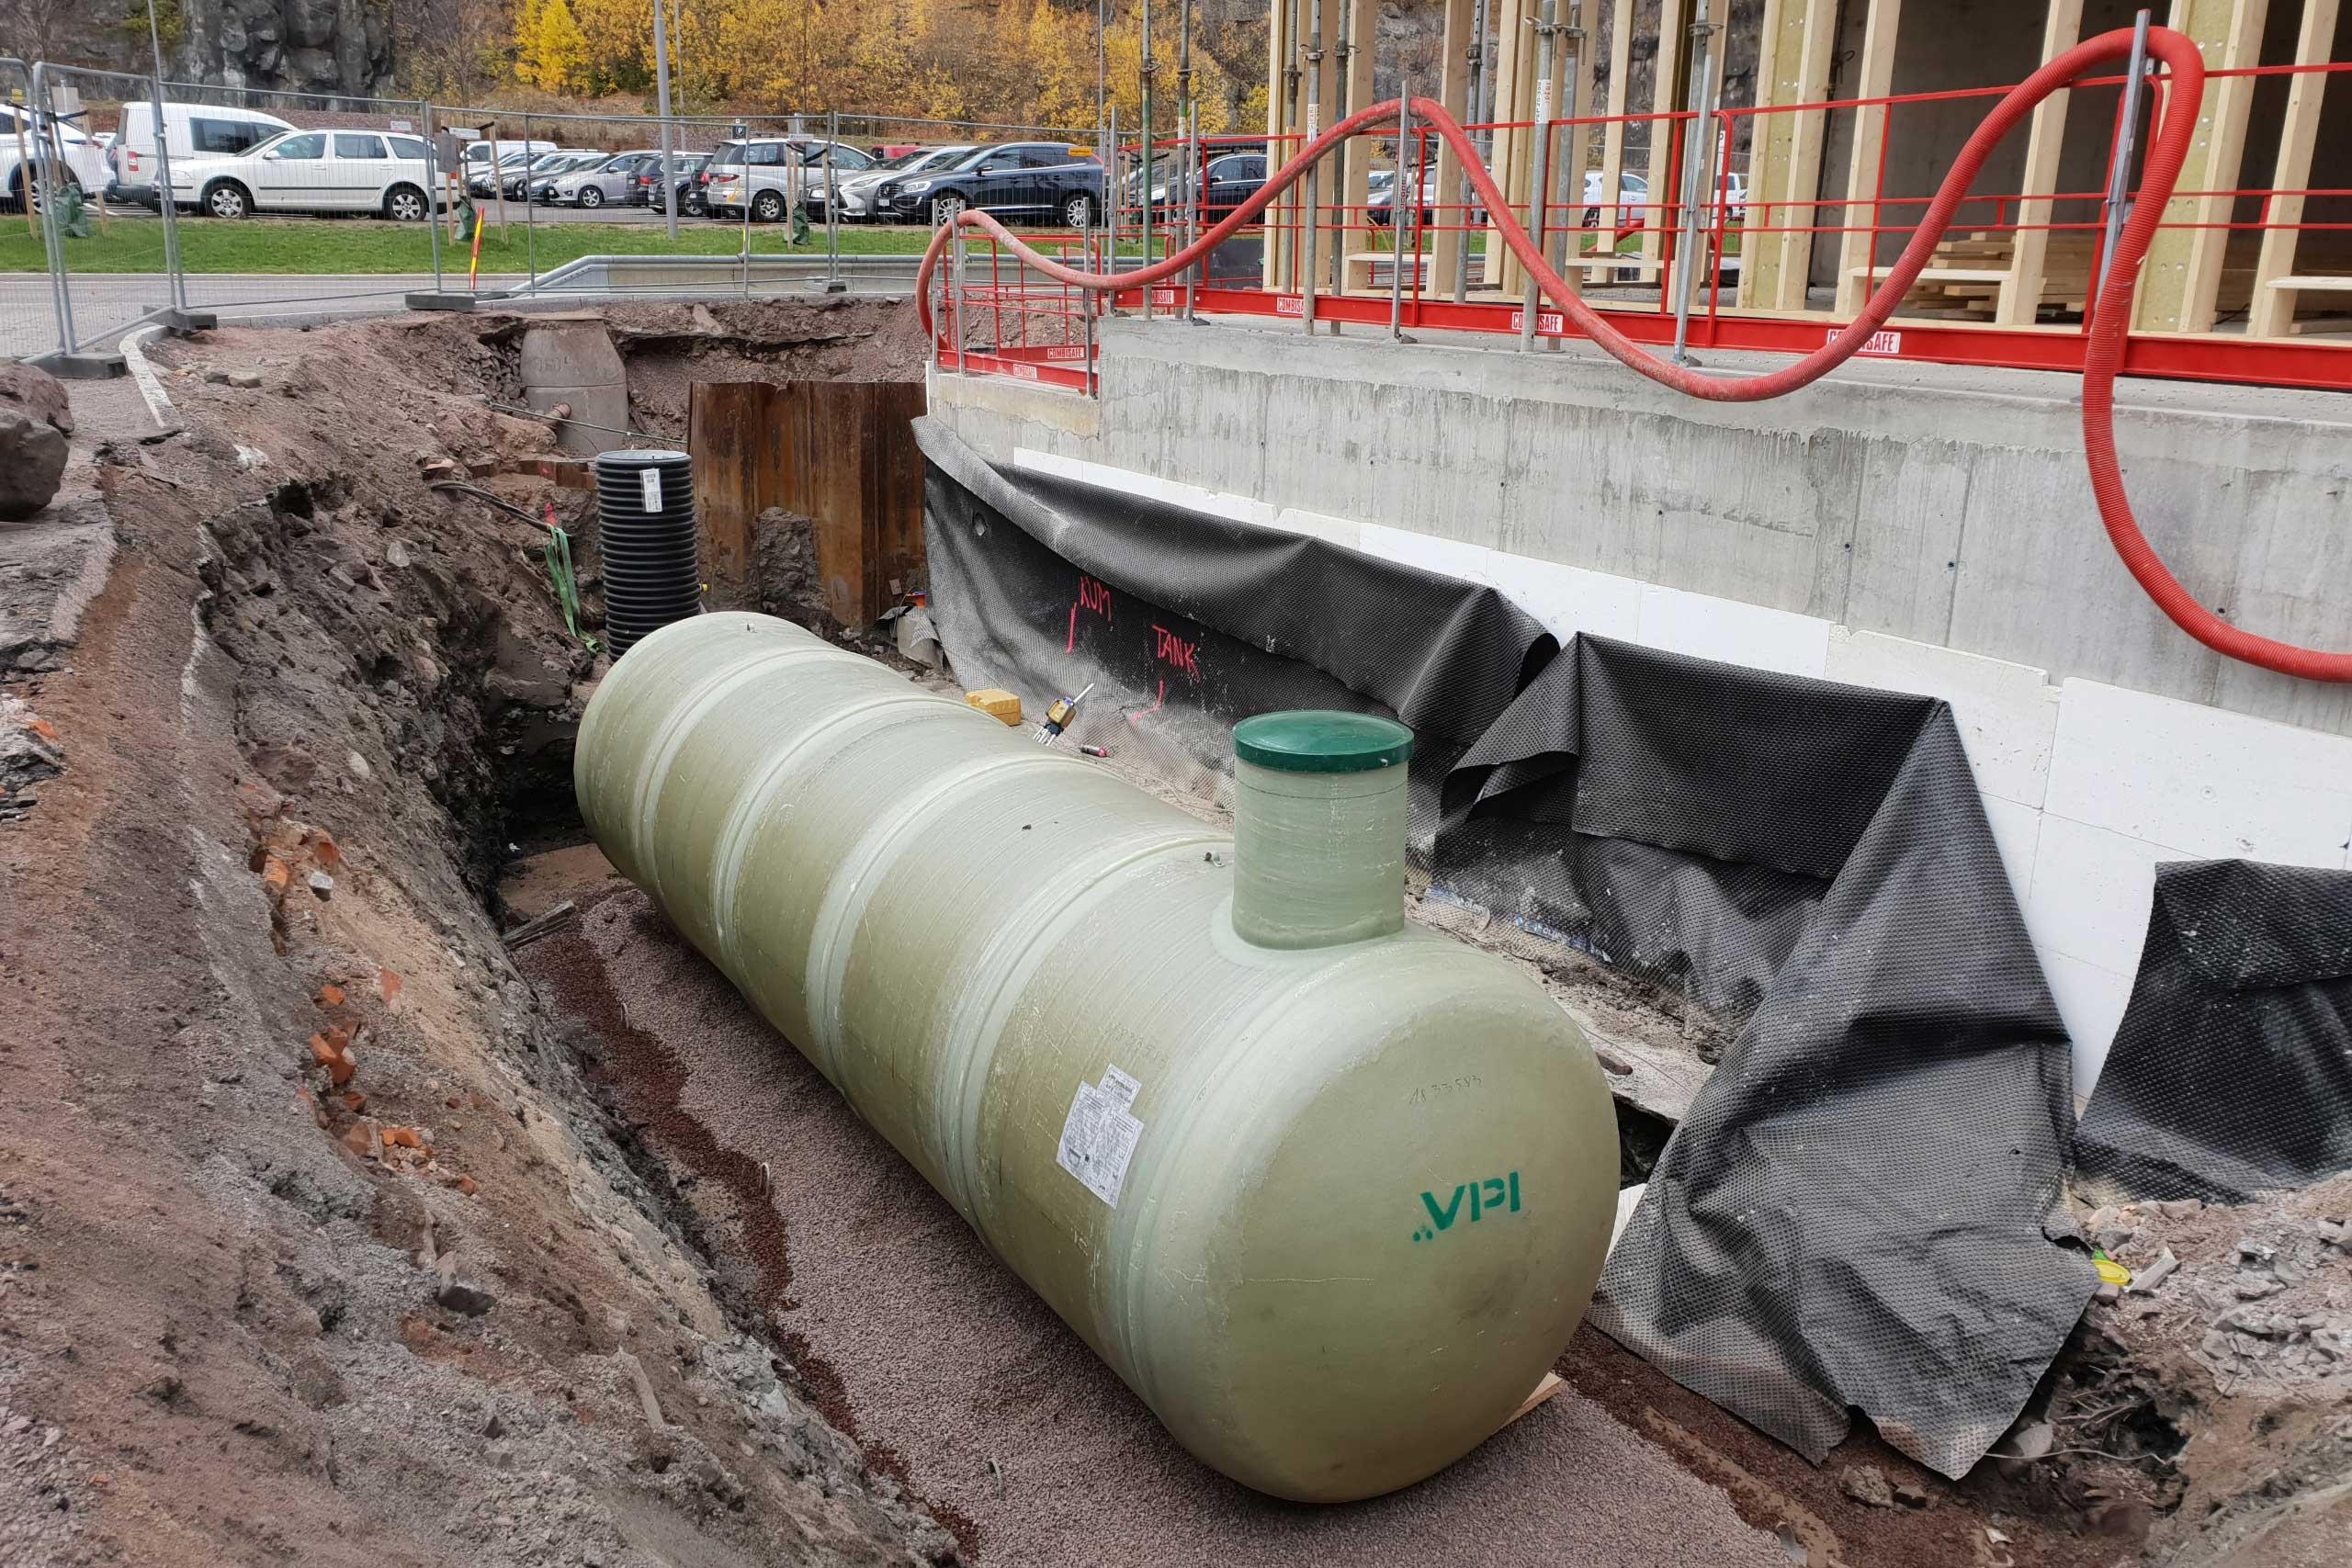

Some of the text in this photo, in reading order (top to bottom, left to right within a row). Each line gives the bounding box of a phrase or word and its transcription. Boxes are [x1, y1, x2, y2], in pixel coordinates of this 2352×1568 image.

[1513, 313, 1559, 332] COISAFE
[1828, 331, 1894, 351] CSAFE
[1151, 624, 1201, 683] TANK
[1419, 1171, 1521, 1231] VPI
